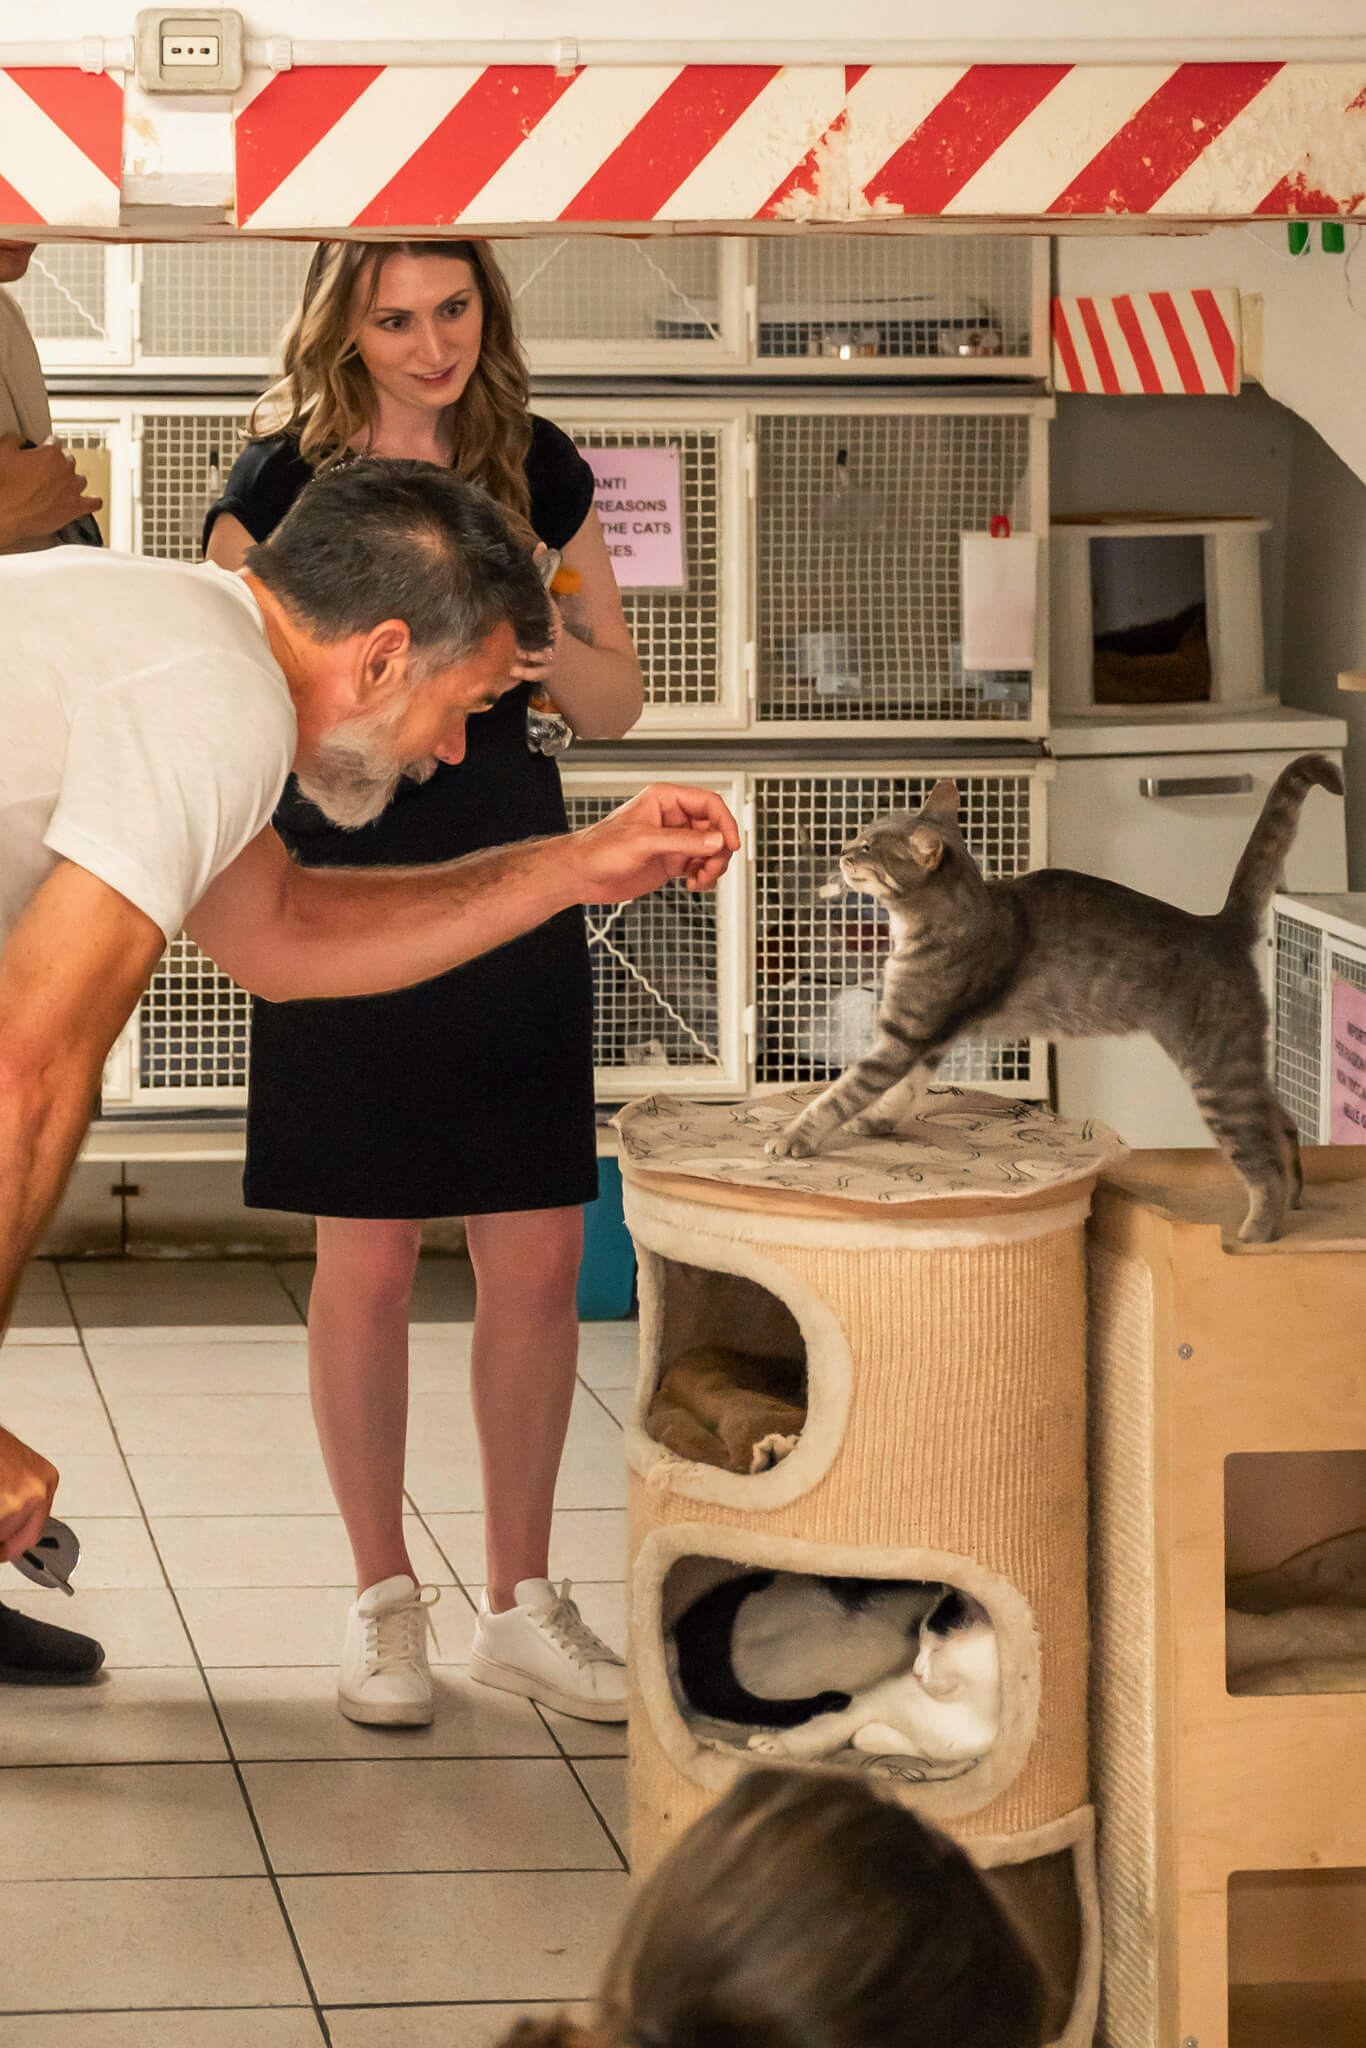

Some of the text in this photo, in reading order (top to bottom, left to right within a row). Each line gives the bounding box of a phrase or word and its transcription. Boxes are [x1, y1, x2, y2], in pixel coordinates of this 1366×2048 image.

[594, 500, 667, 512] REASONS
[601, 523, 671, 534] THE CATS
